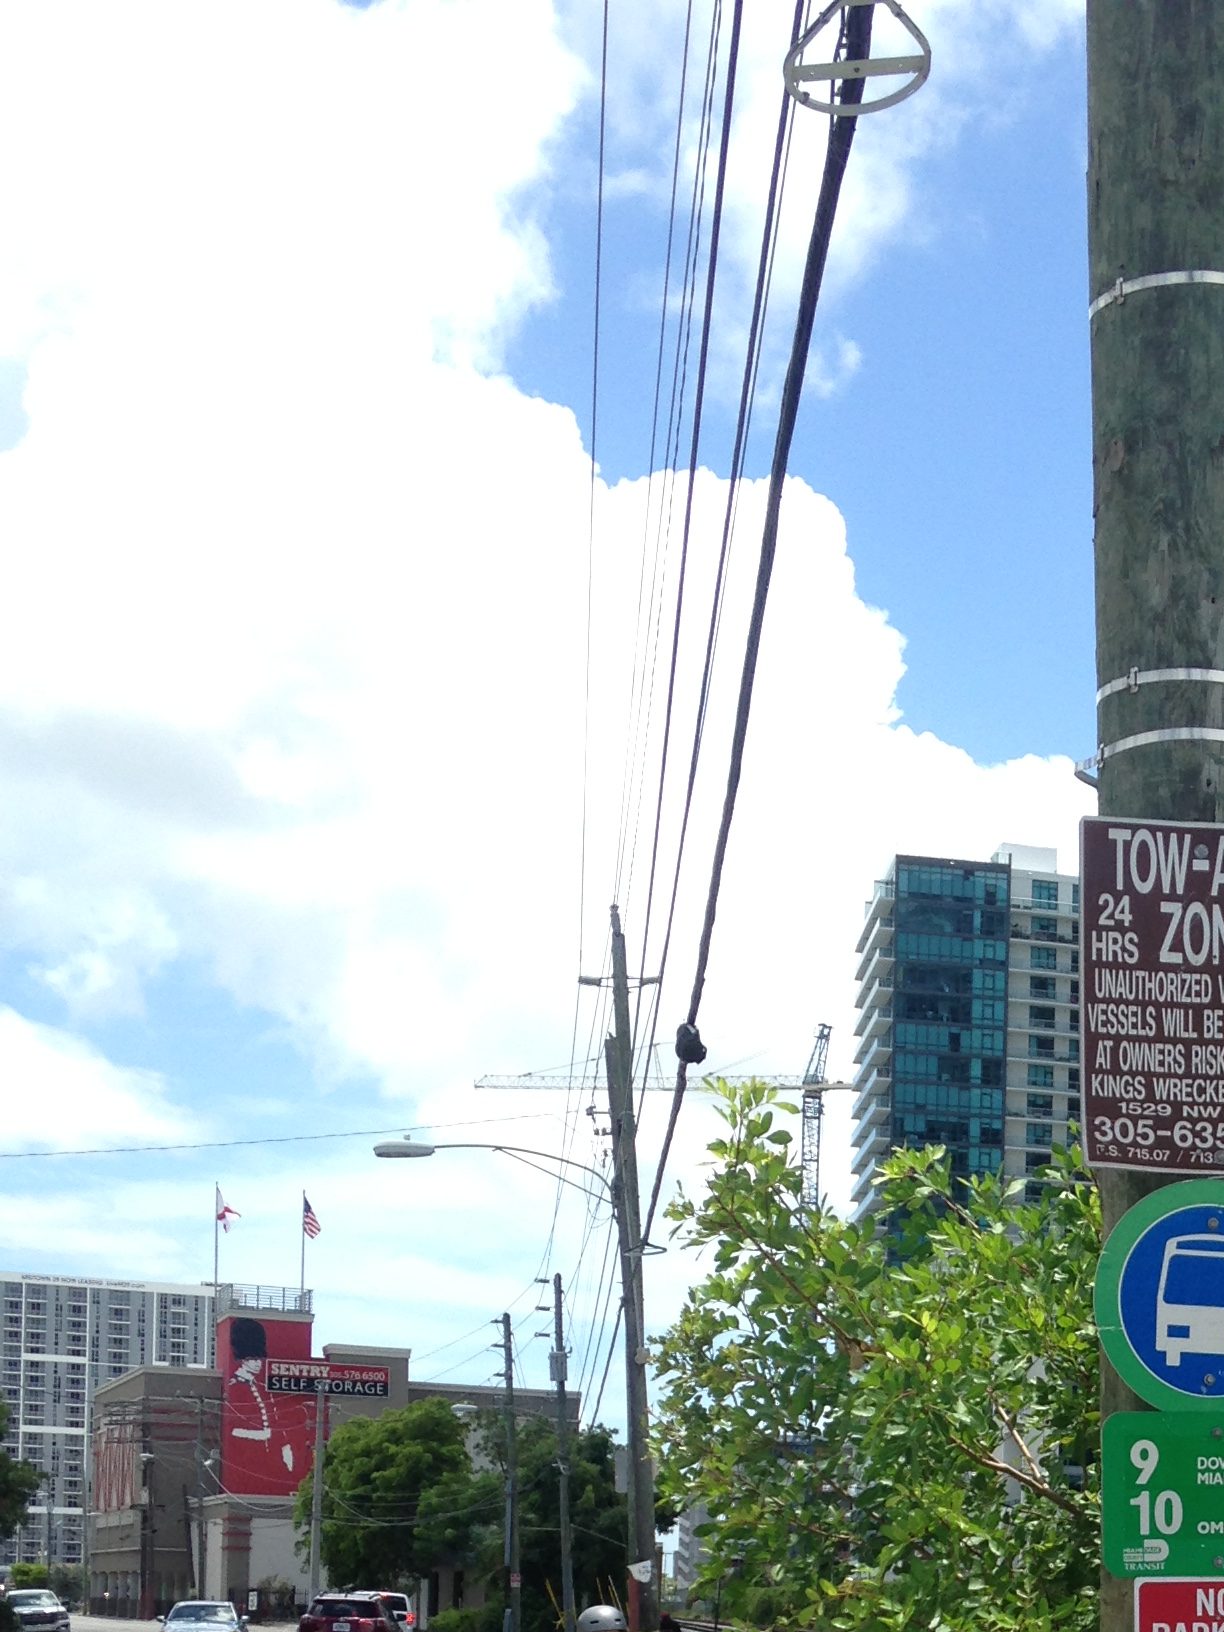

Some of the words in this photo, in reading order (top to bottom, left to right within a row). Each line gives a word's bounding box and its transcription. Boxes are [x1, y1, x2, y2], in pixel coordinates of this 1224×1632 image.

[1098, 894, 1133, 926] 24
[1092, 931, 1139, 964] HRS
[1094, 968, 1212, 1004] UNAUTHORIZED
[1088, 1003, 1156, 1037] VESSELS
[1162, 1008, 1197, 1039] WILL
[1203, 1010, 1224, 1039] BE
[1095, 1040, 1114, 1069] AT
[1119, 1042, 1185, 1075] OWNERS
[1092, 1074, 1145, 1099] KINGS
[1118, 1102, 1172, 1116] 1529
[1182, 1105, 1221, 1118] NW
[1127, 1146, 1170, 1161] 715.07
[1176, 1151, 1183, 1162] /
[271, 1363, 330, 1377] SENTRY
[272, 1377, 307, 1390] SELF
[314, 1379, 385, 1395] STORAGE
[1129, 1439, 1160, 1485] 9
[1129, 1490, 1184, 1536] 10
[1124, 1562, 1165, 1571] TRANSIT
